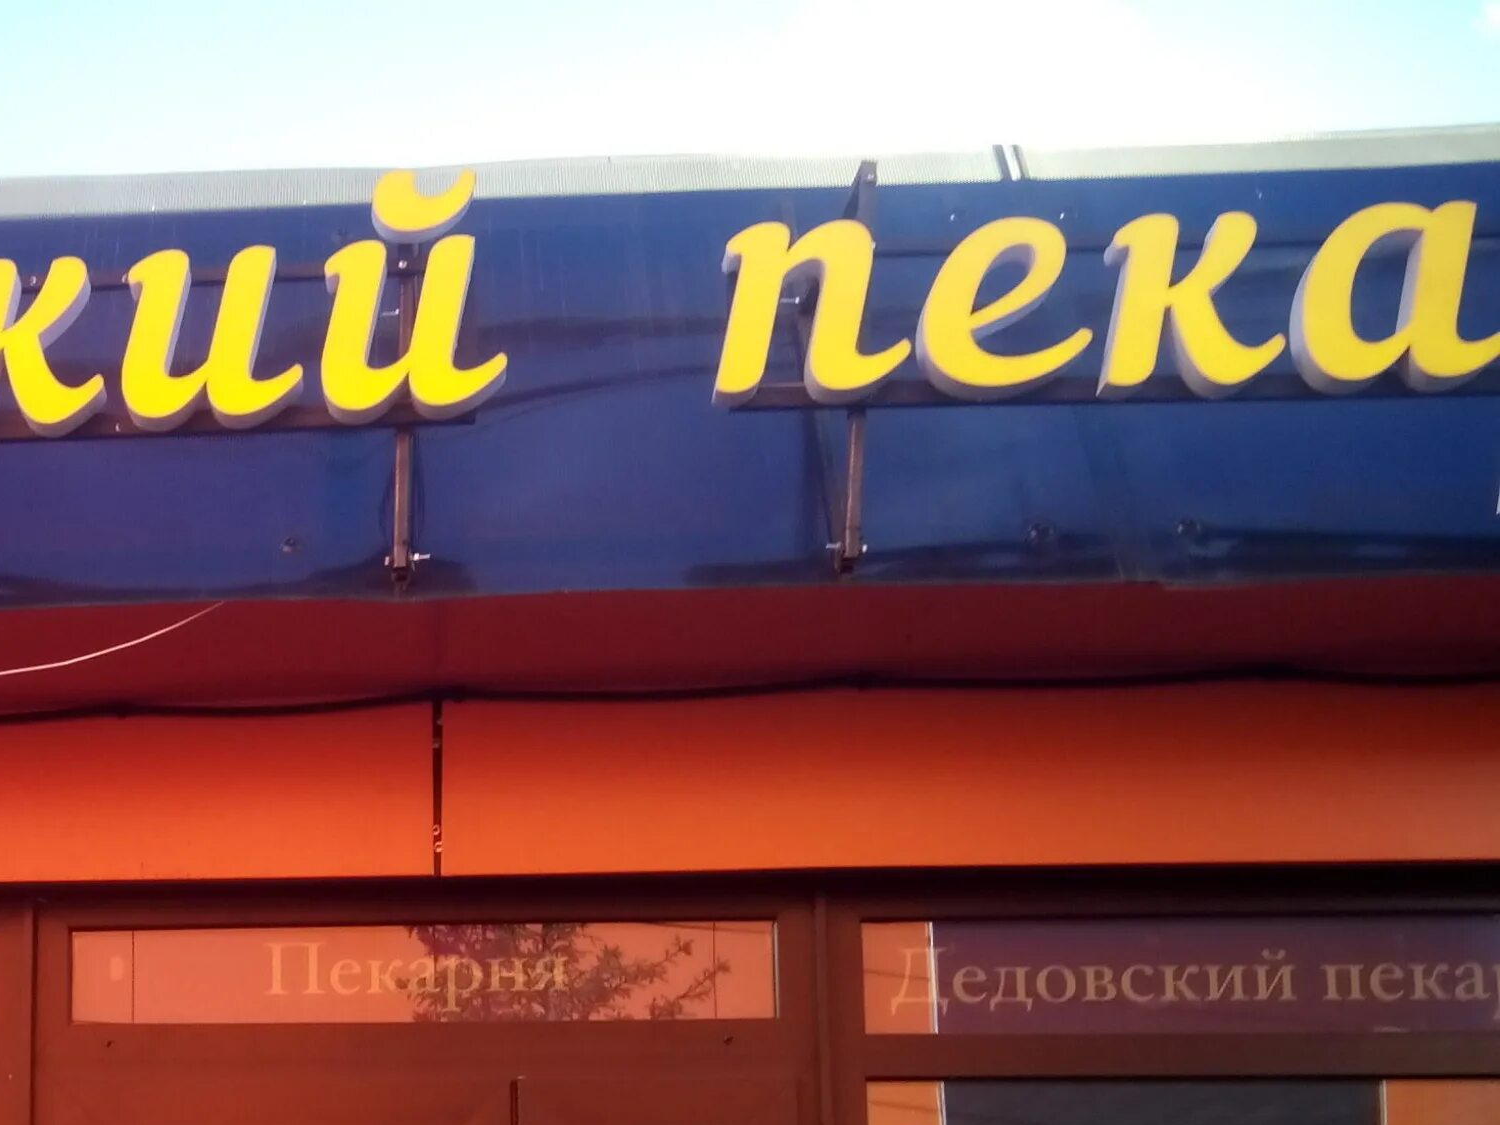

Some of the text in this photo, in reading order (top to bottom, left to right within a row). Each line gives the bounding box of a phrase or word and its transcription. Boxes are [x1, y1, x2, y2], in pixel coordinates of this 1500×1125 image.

[712, 199, 1500, 403] пека
[264, 940, 570, 1013] Пекарня
[890, 947, 1500, 1021] Дедовский пека
